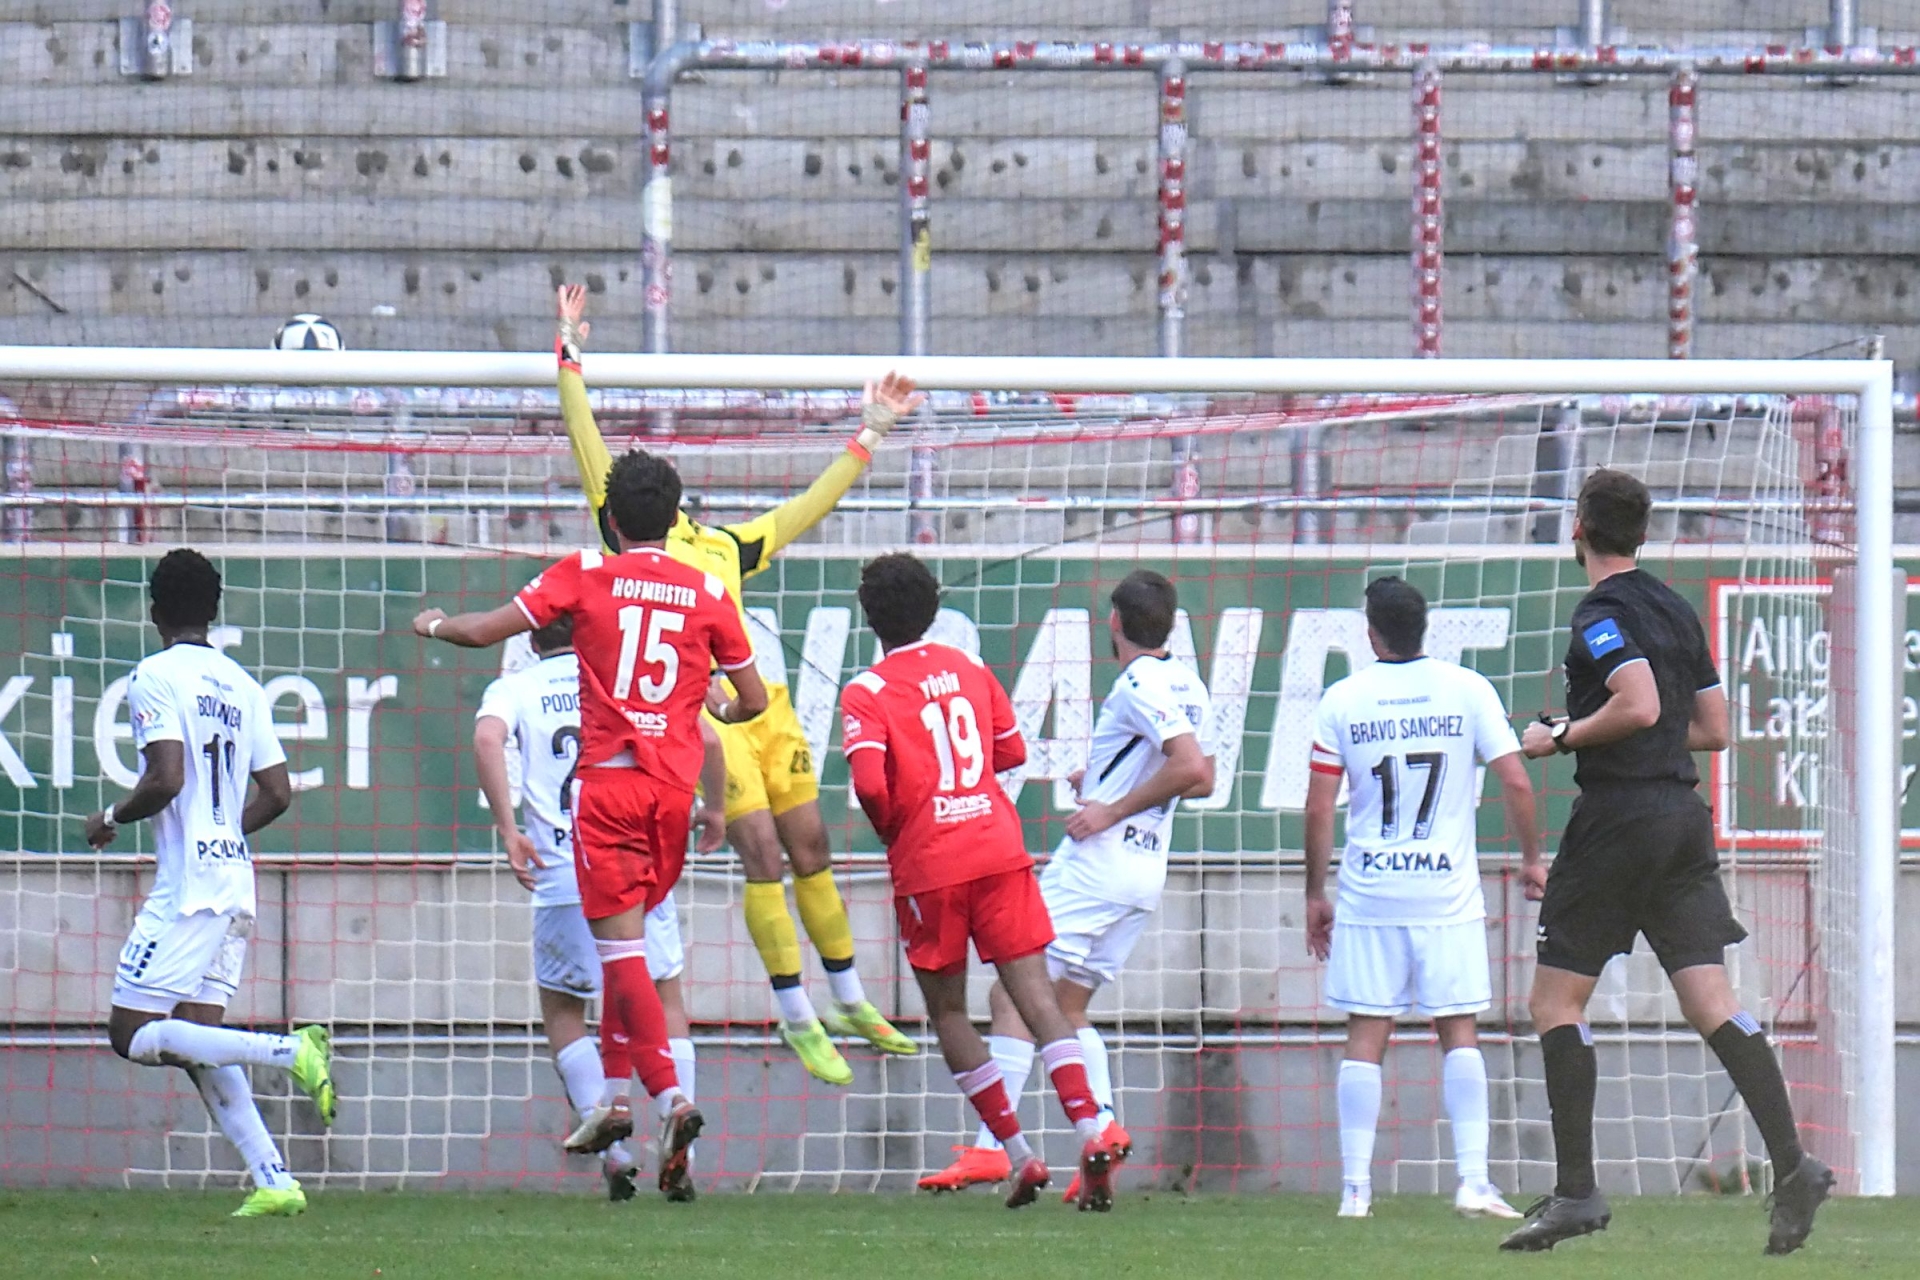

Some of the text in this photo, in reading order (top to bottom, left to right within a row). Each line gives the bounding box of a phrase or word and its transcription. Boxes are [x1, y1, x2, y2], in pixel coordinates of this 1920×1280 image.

[612, 577, 697, 608] HOFMEISTER
[613, 604, 686, 704] 15
[920, 696, 985, 791] 19
[1350, 715, 1464, 745] BRAVO SANCHEZ
[1371, 752, 1448, 840] 17
[1362, 852, 1452, 872] POLYMA
